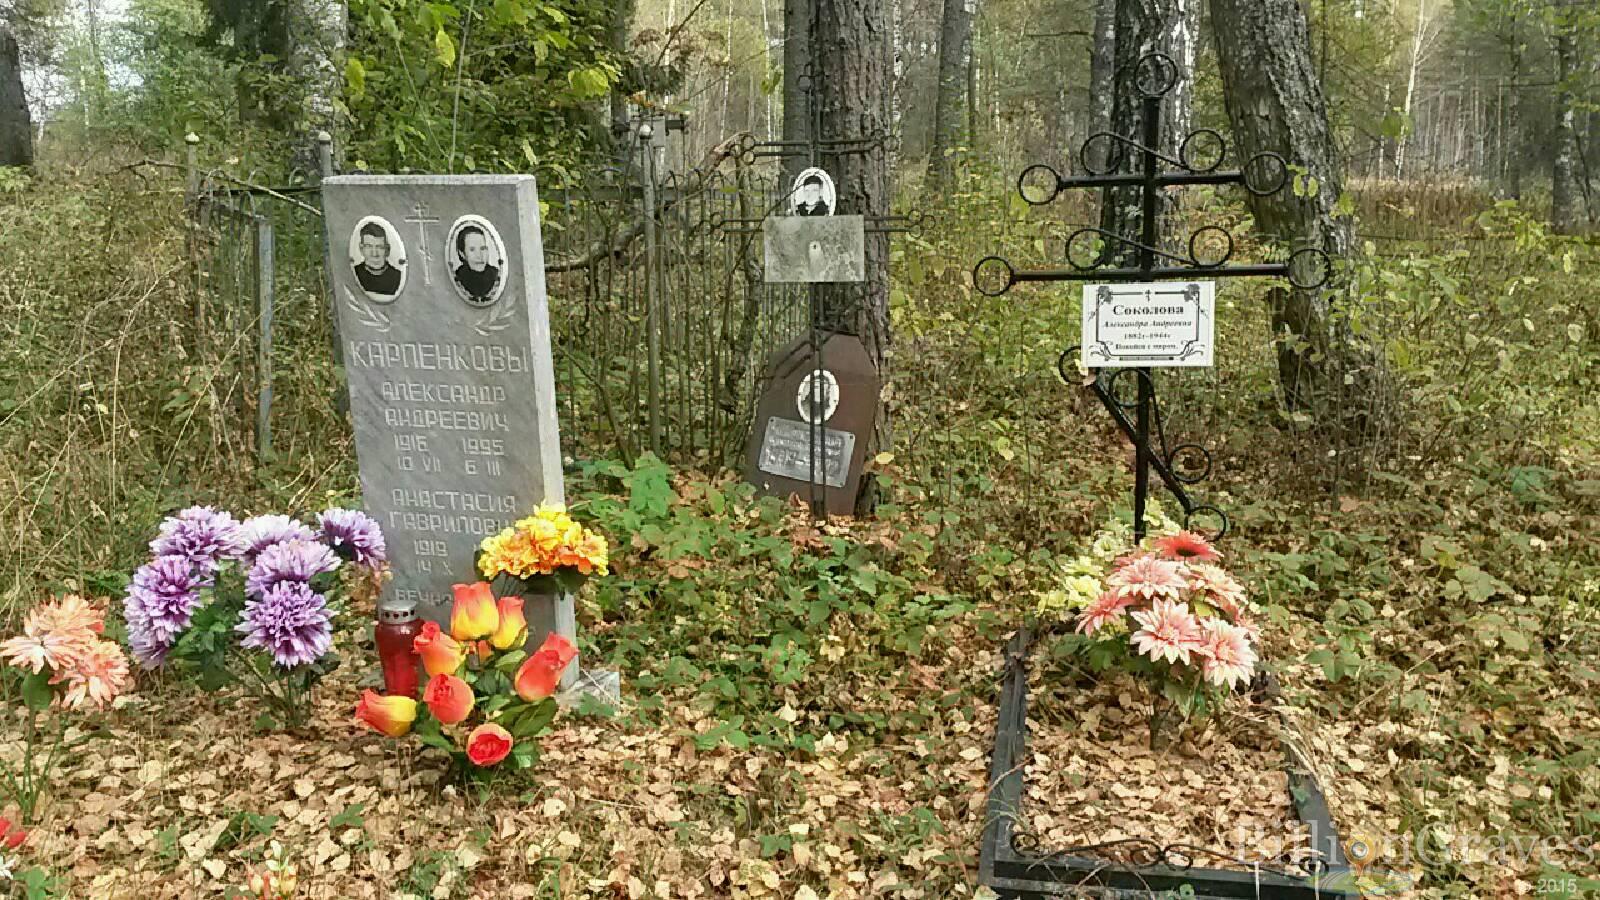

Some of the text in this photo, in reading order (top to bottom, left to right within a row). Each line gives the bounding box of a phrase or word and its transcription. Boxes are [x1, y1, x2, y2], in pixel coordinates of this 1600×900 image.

[1112, 304, 1184, 316] Соколова
[350, 340, 530, 373] КАРПЕНКОВЫ
[381, 381, 506, 406] АЛЕКСАНДР
[384, 408, 510, 433] АНДРЕЕВИЧ
[393, 434, 506, 456] 1916 1995
[397, 456, 414, 472] 10
[465, 459, 478, 475] 6
[392, 488, 517, 514] АНАСТАСИЯ
[413, 539, 449, 557] 1919
[417, 559, 432, 575] 14
